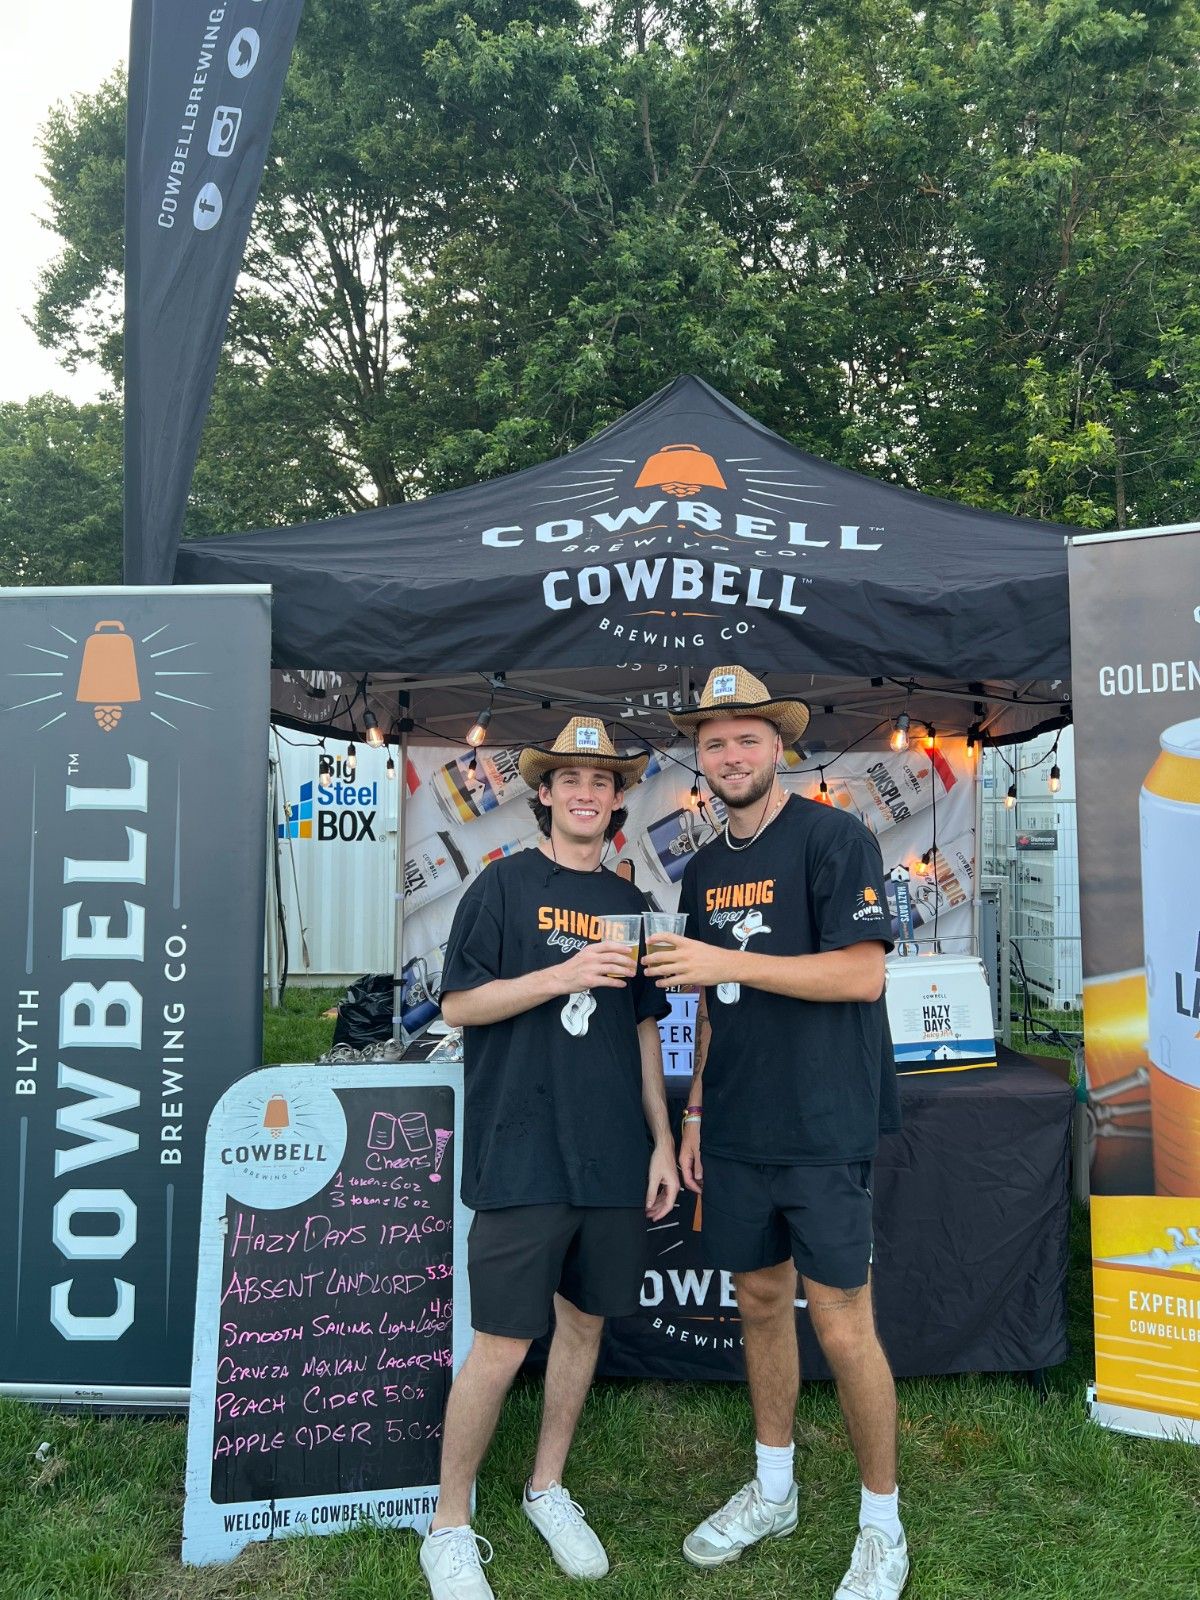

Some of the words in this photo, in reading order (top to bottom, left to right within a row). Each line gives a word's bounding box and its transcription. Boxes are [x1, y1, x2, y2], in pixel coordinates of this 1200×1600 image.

[482, 501, 883, 551] COWBELL
[542, 558, 807, 615] COWBELL
[599, 617, 705, 648] BREWING
[319, 754, 356, 784] Big
[317, 781, 378, 806] Steel
[866, 762, 912, 824] SUNSPLASH
[317, 810, 377, 842] BOX
[706, 879, 774, 912] SHINDIG
[922, 1004, 950, 1020] HAZY
[924, 1018, 952, 1033] DAYS
[15, 989, 40, 1096] BLYTH
[50, 754, 149, 1341] COWBELL
[160, 1002, 186, 1165] BREWING
[220, 1143, 328, 1166] COWBELL
[243, 1167, 288, 1181] BREWING
[380, 1223, 423, 1245] IPA
[325, 1267, 426, 1297] LANDLORD
[216, 1392, 286, 1423] PEACH
[303, 1385, 378, 1414] CIDER
[213, 1431, 285, 1461] APPLE
[224, 1509, 291, 1533] WELCOME
[311, 1503, 373, 1524] COWBELL
[377, 1496, 438, 1518] COUNTRY
